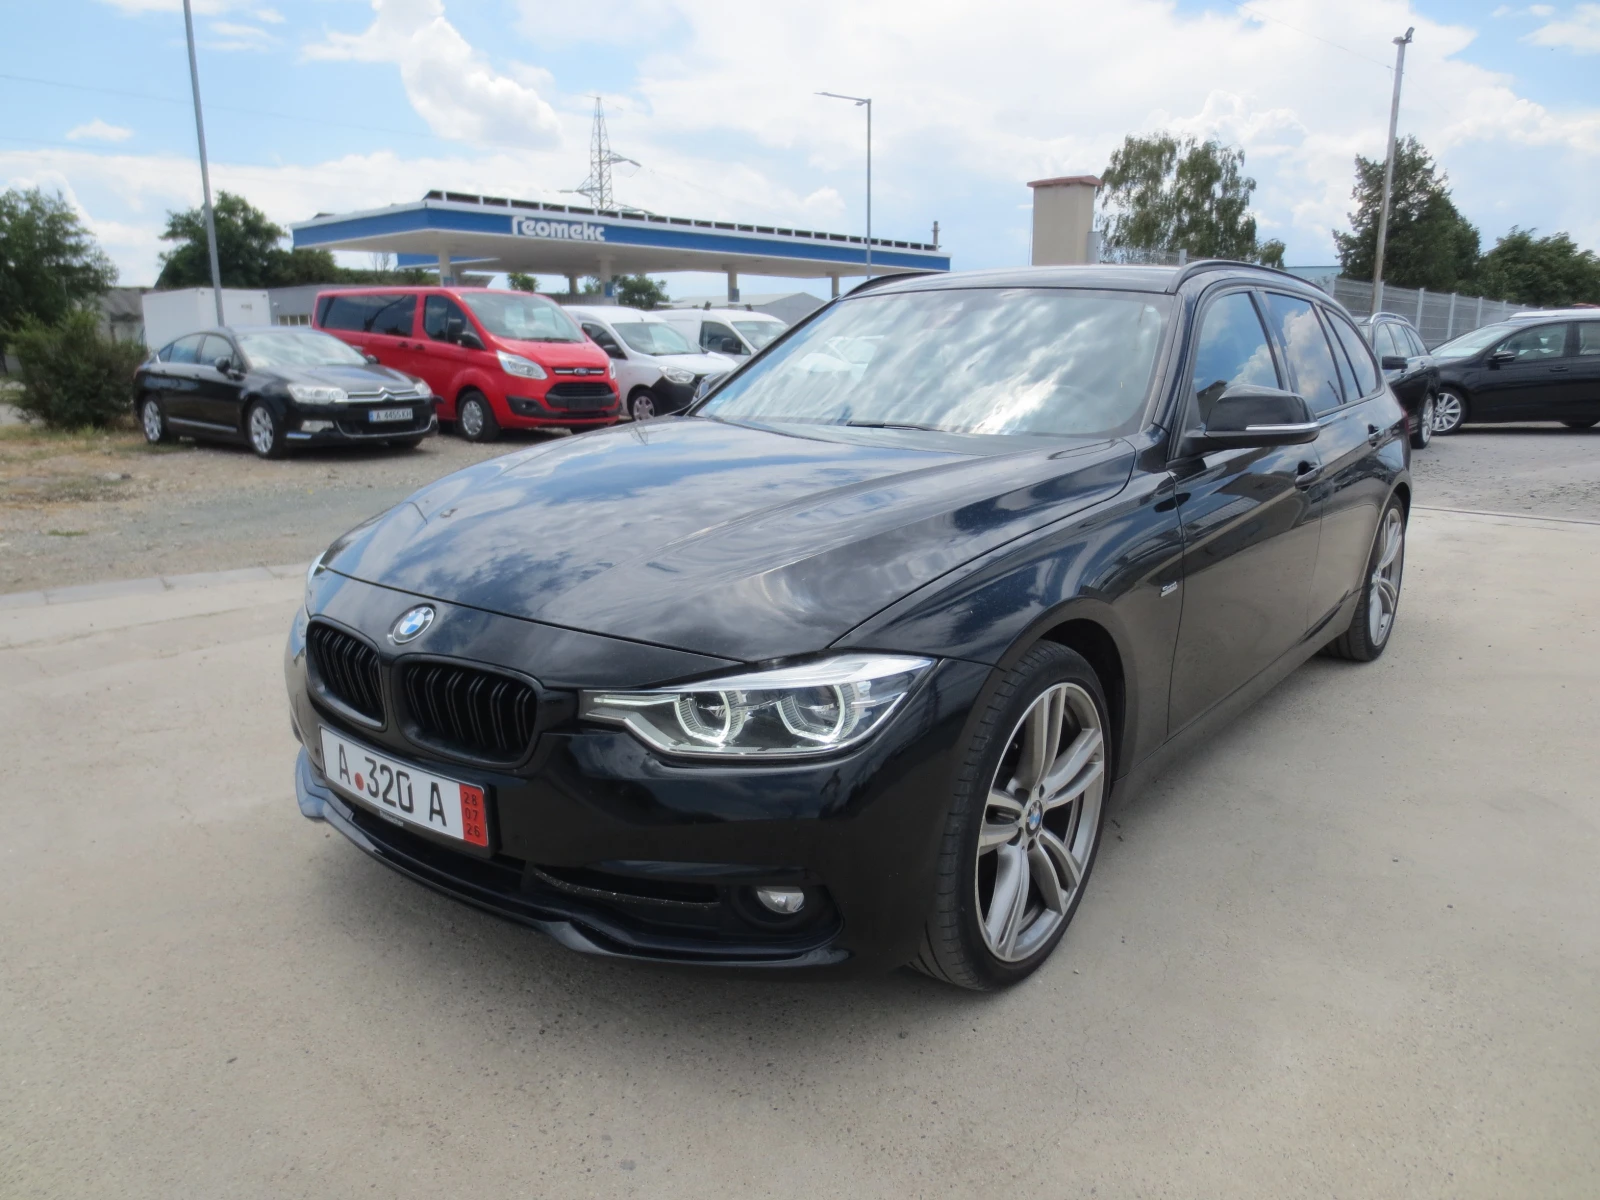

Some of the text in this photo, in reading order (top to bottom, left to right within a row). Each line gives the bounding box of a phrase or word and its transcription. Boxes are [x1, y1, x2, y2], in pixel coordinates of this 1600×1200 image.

[339, 743, 447, 827] A 320 A
[464, 791, 478, 806] 28
[465, 807, 478, 820] 07
[466, 822, 480, 838] 26
